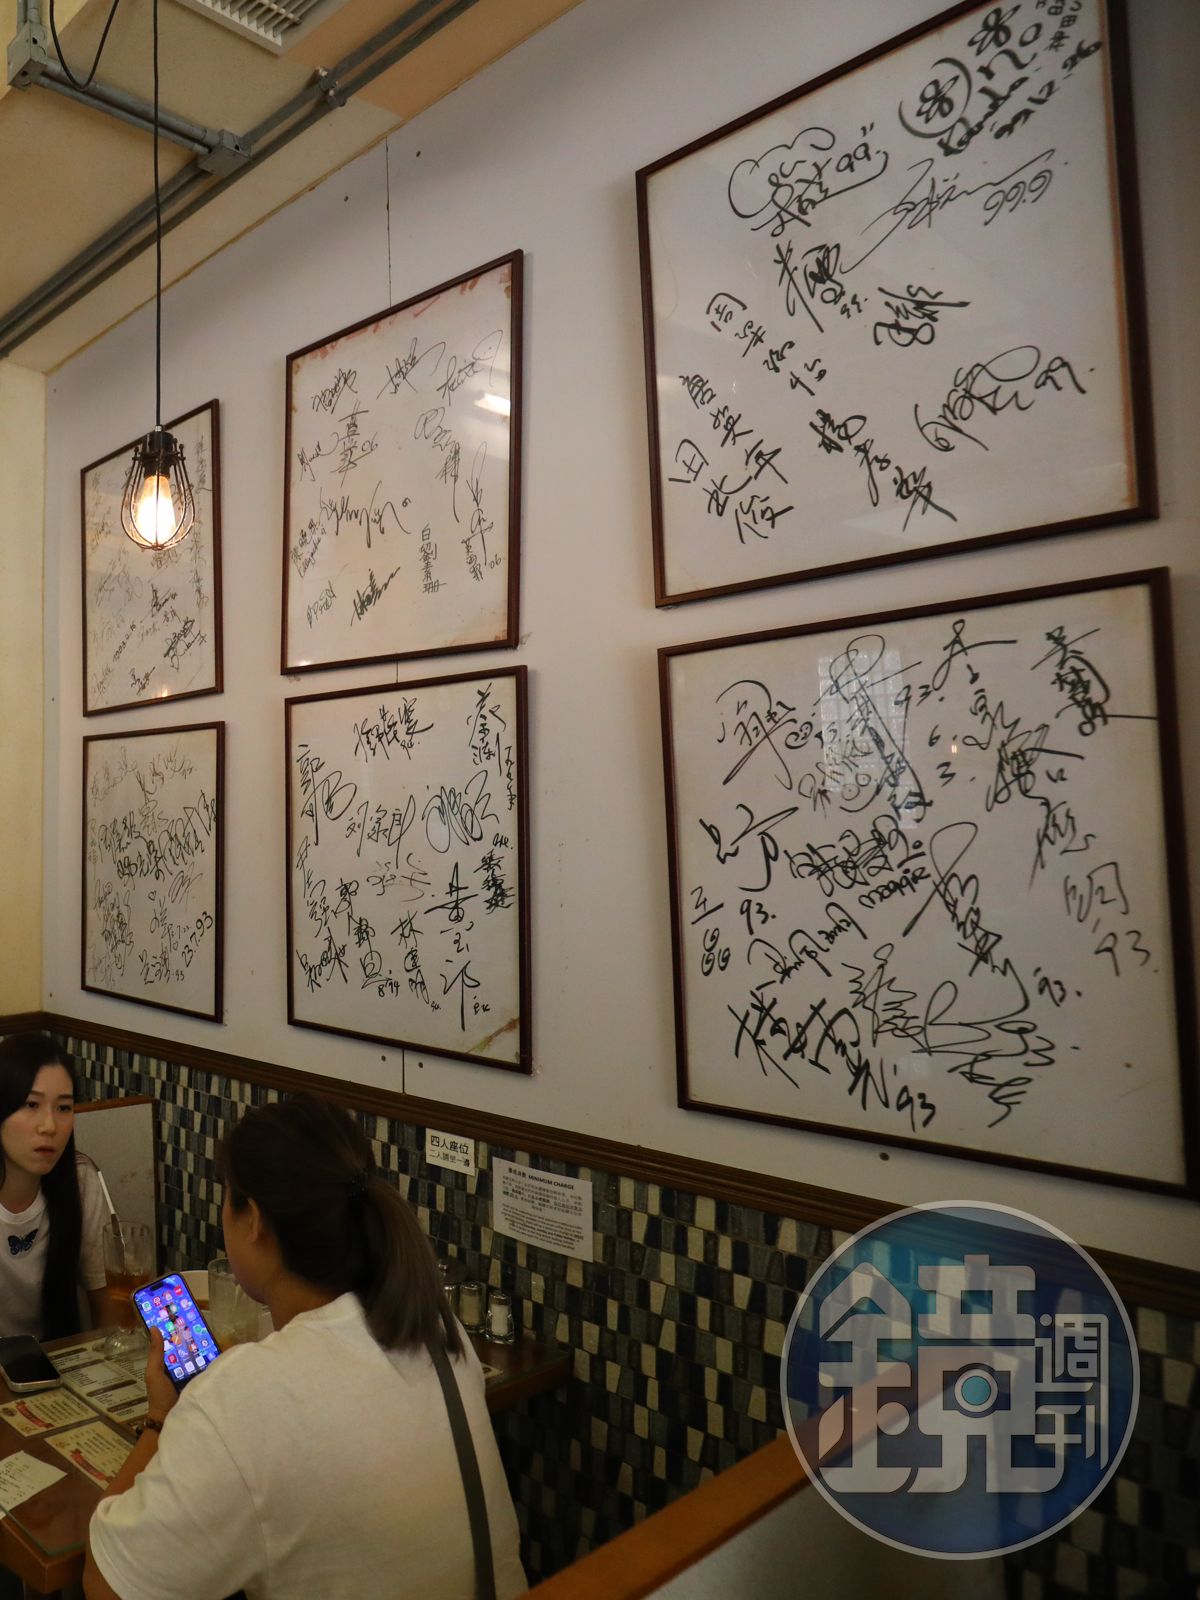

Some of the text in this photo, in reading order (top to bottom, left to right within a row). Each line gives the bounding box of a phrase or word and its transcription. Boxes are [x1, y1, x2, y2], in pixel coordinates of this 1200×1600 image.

[430, 1135, 469, 1155] 四人座位
[528, 1175, 553, 1185] MINIMUM
[553, 1180, 575, 1191] CHARGE
